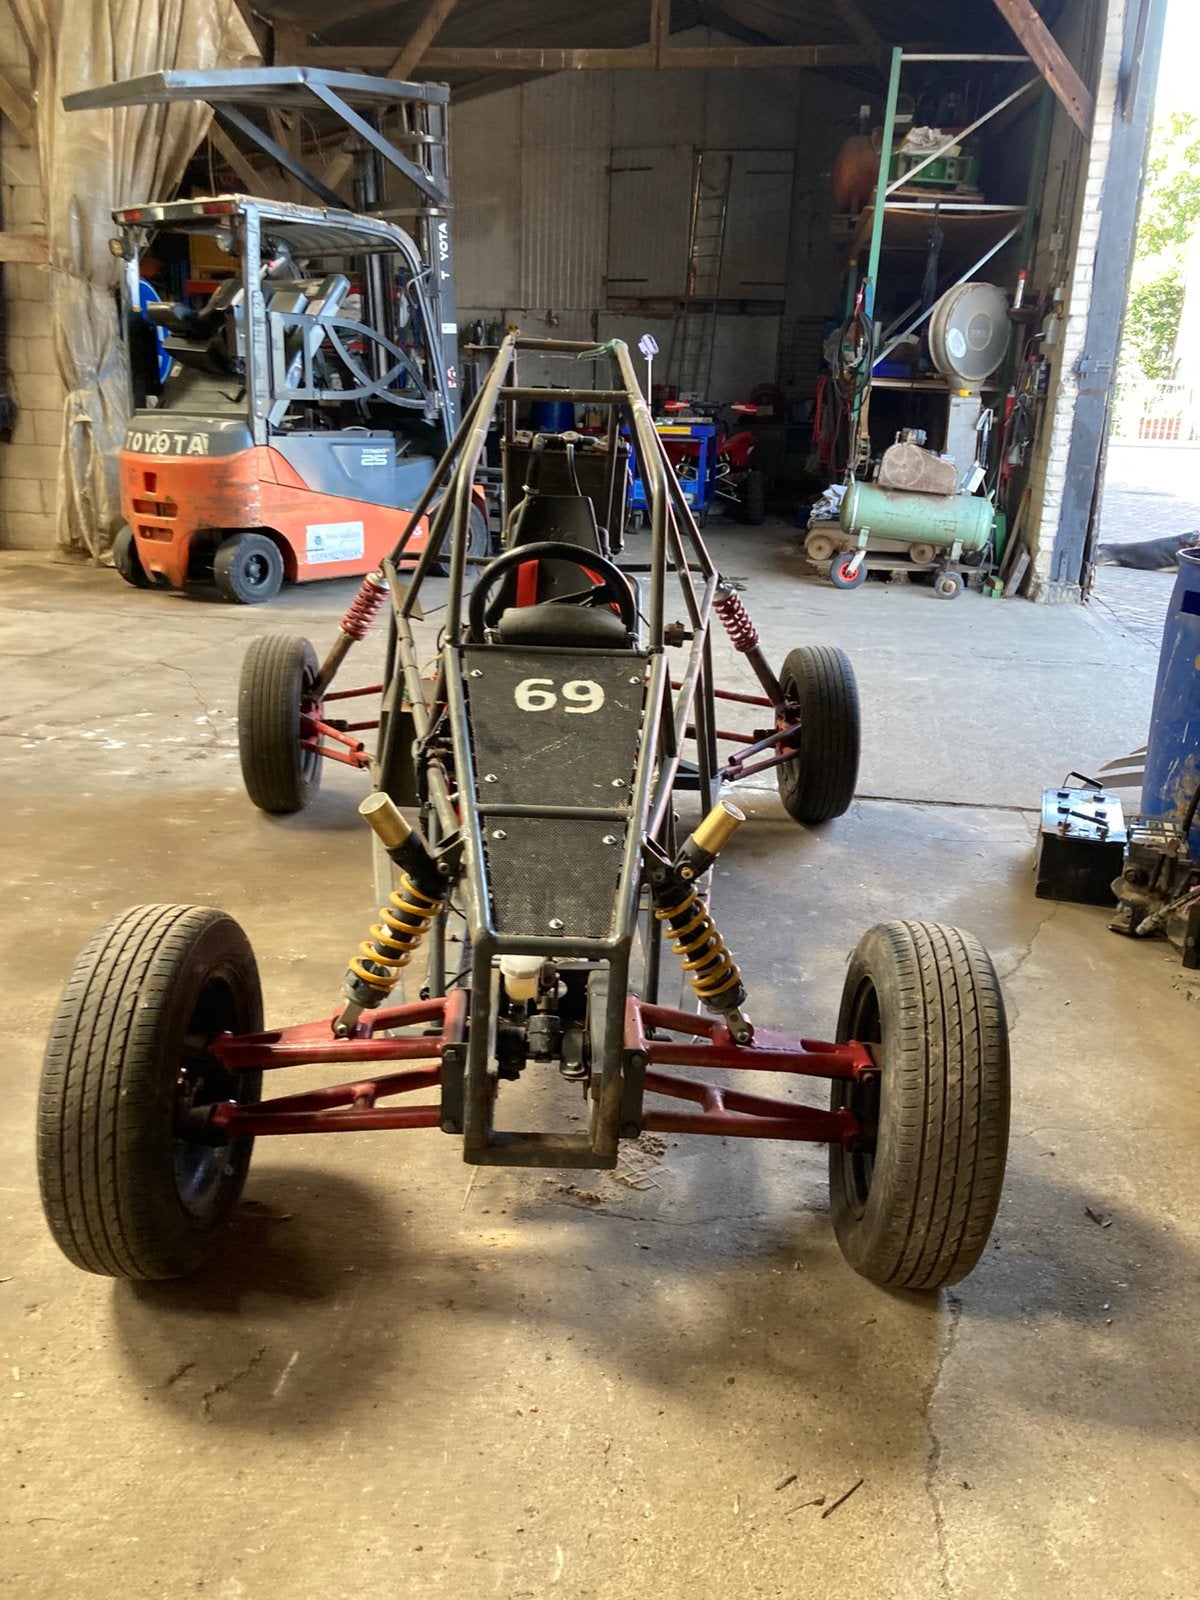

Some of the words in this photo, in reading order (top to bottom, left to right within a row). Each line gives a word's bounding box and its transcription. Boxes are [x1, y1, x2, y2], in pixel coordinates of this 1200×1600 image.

[126, 431, 207, 455] TOYOTA
[361, 454, 388, 466] 25
[514, 678, 605, 714] 69
